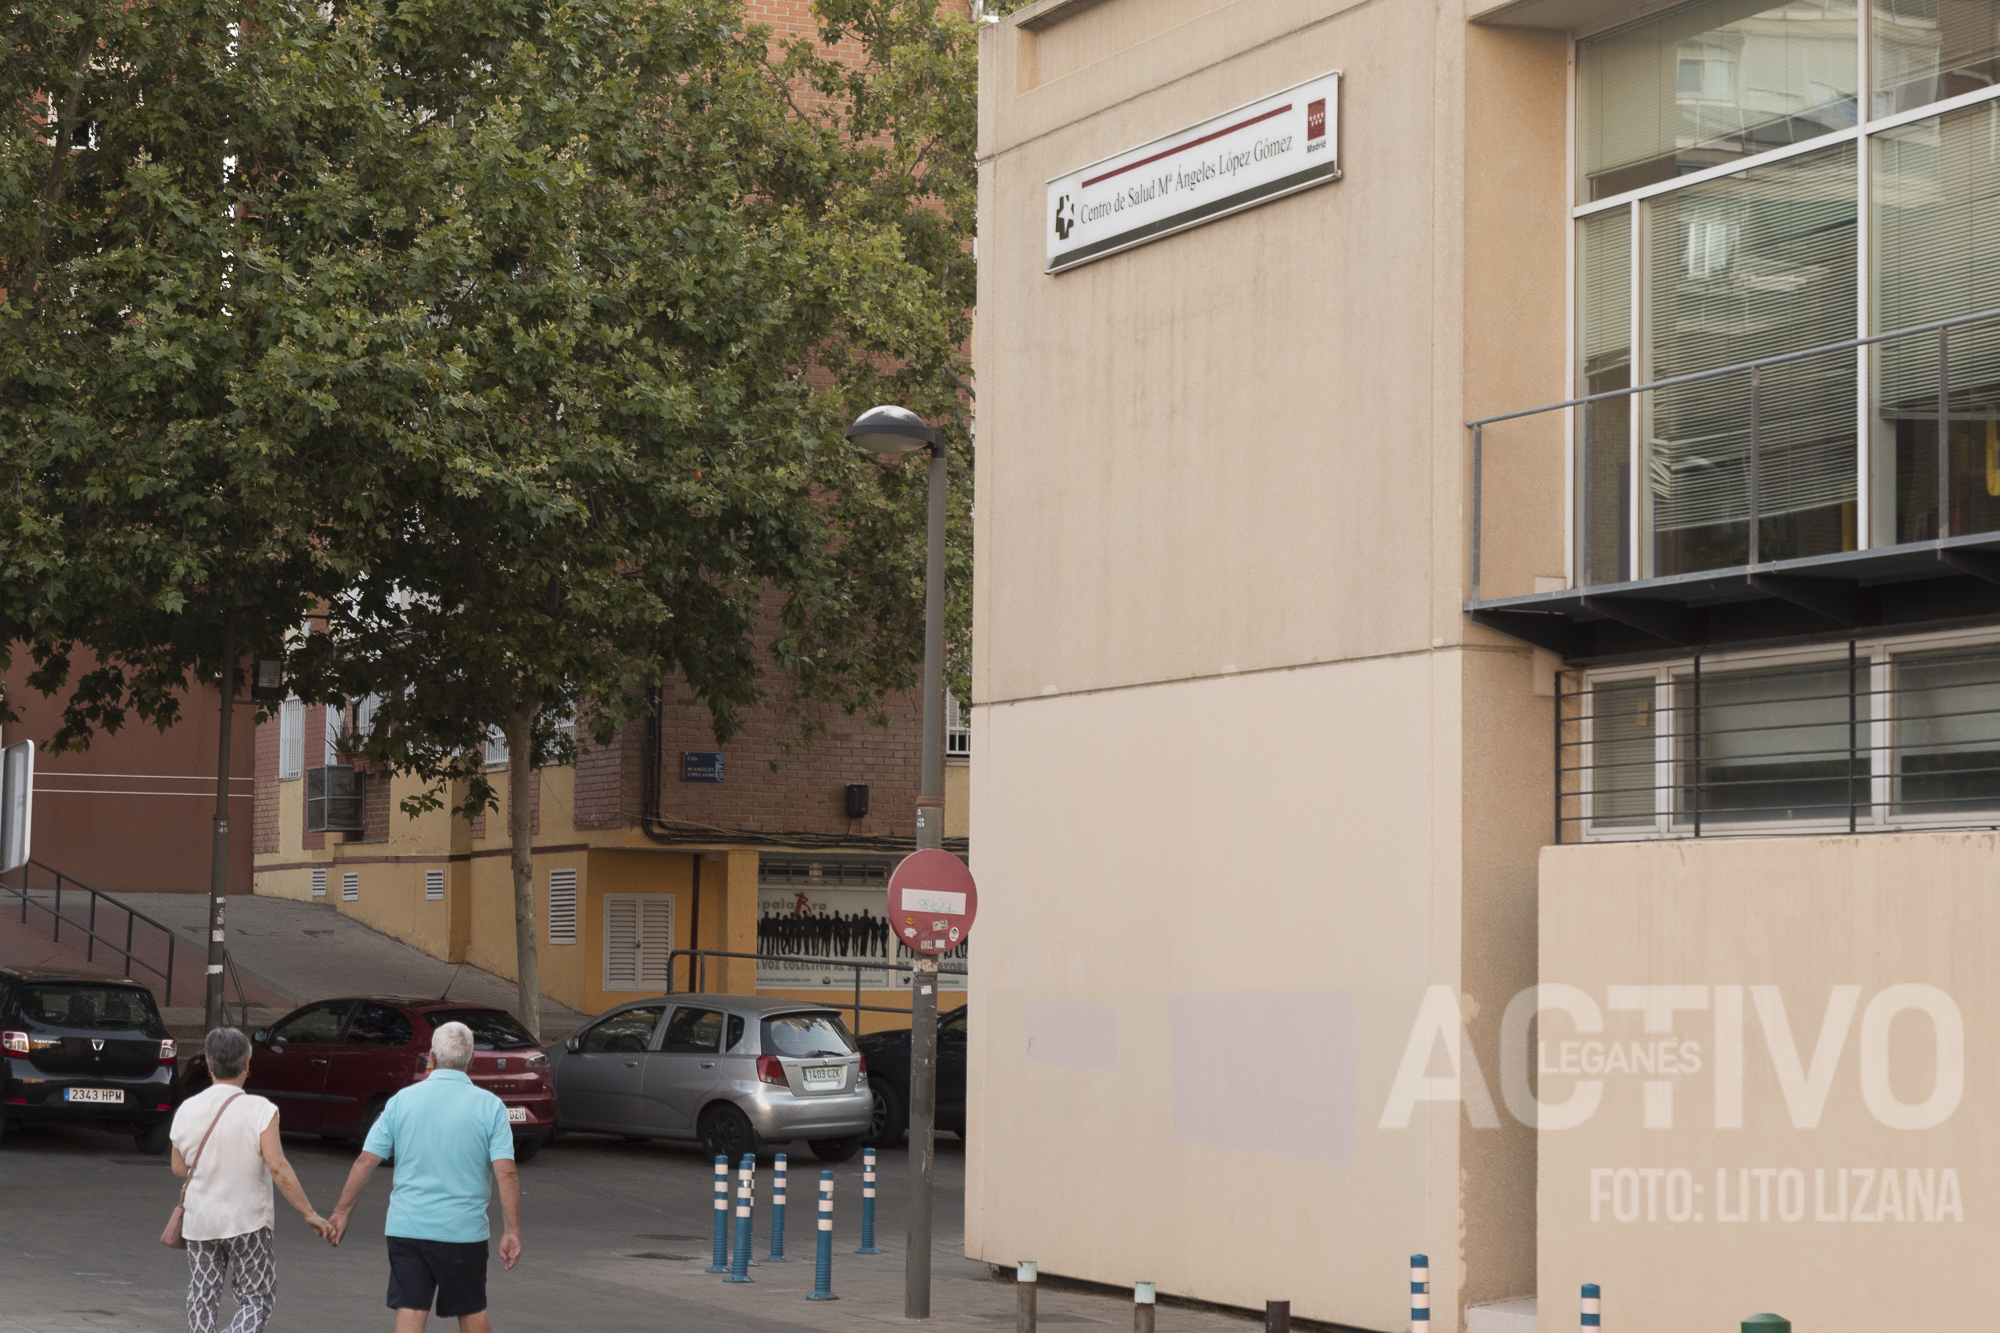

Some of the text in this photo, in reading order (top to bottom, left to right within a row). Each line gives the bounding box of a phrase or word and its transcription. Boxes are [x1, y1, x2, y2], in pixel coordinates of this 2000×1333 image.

[1307, 139, 1327, 154] Madrid
[1080, 135, 1293, 224] Centro de Salud Mª Ángeles López Gómez
[761, 960, 781, 971] VOZ
[783, 960, 831, 972] COLECTIVA
[808, 1068, 841, 1080] 1403 CZK
[72, 1089, 122, 1101] 2343 HPM
[509, 1109, 525, 1120] DZH
